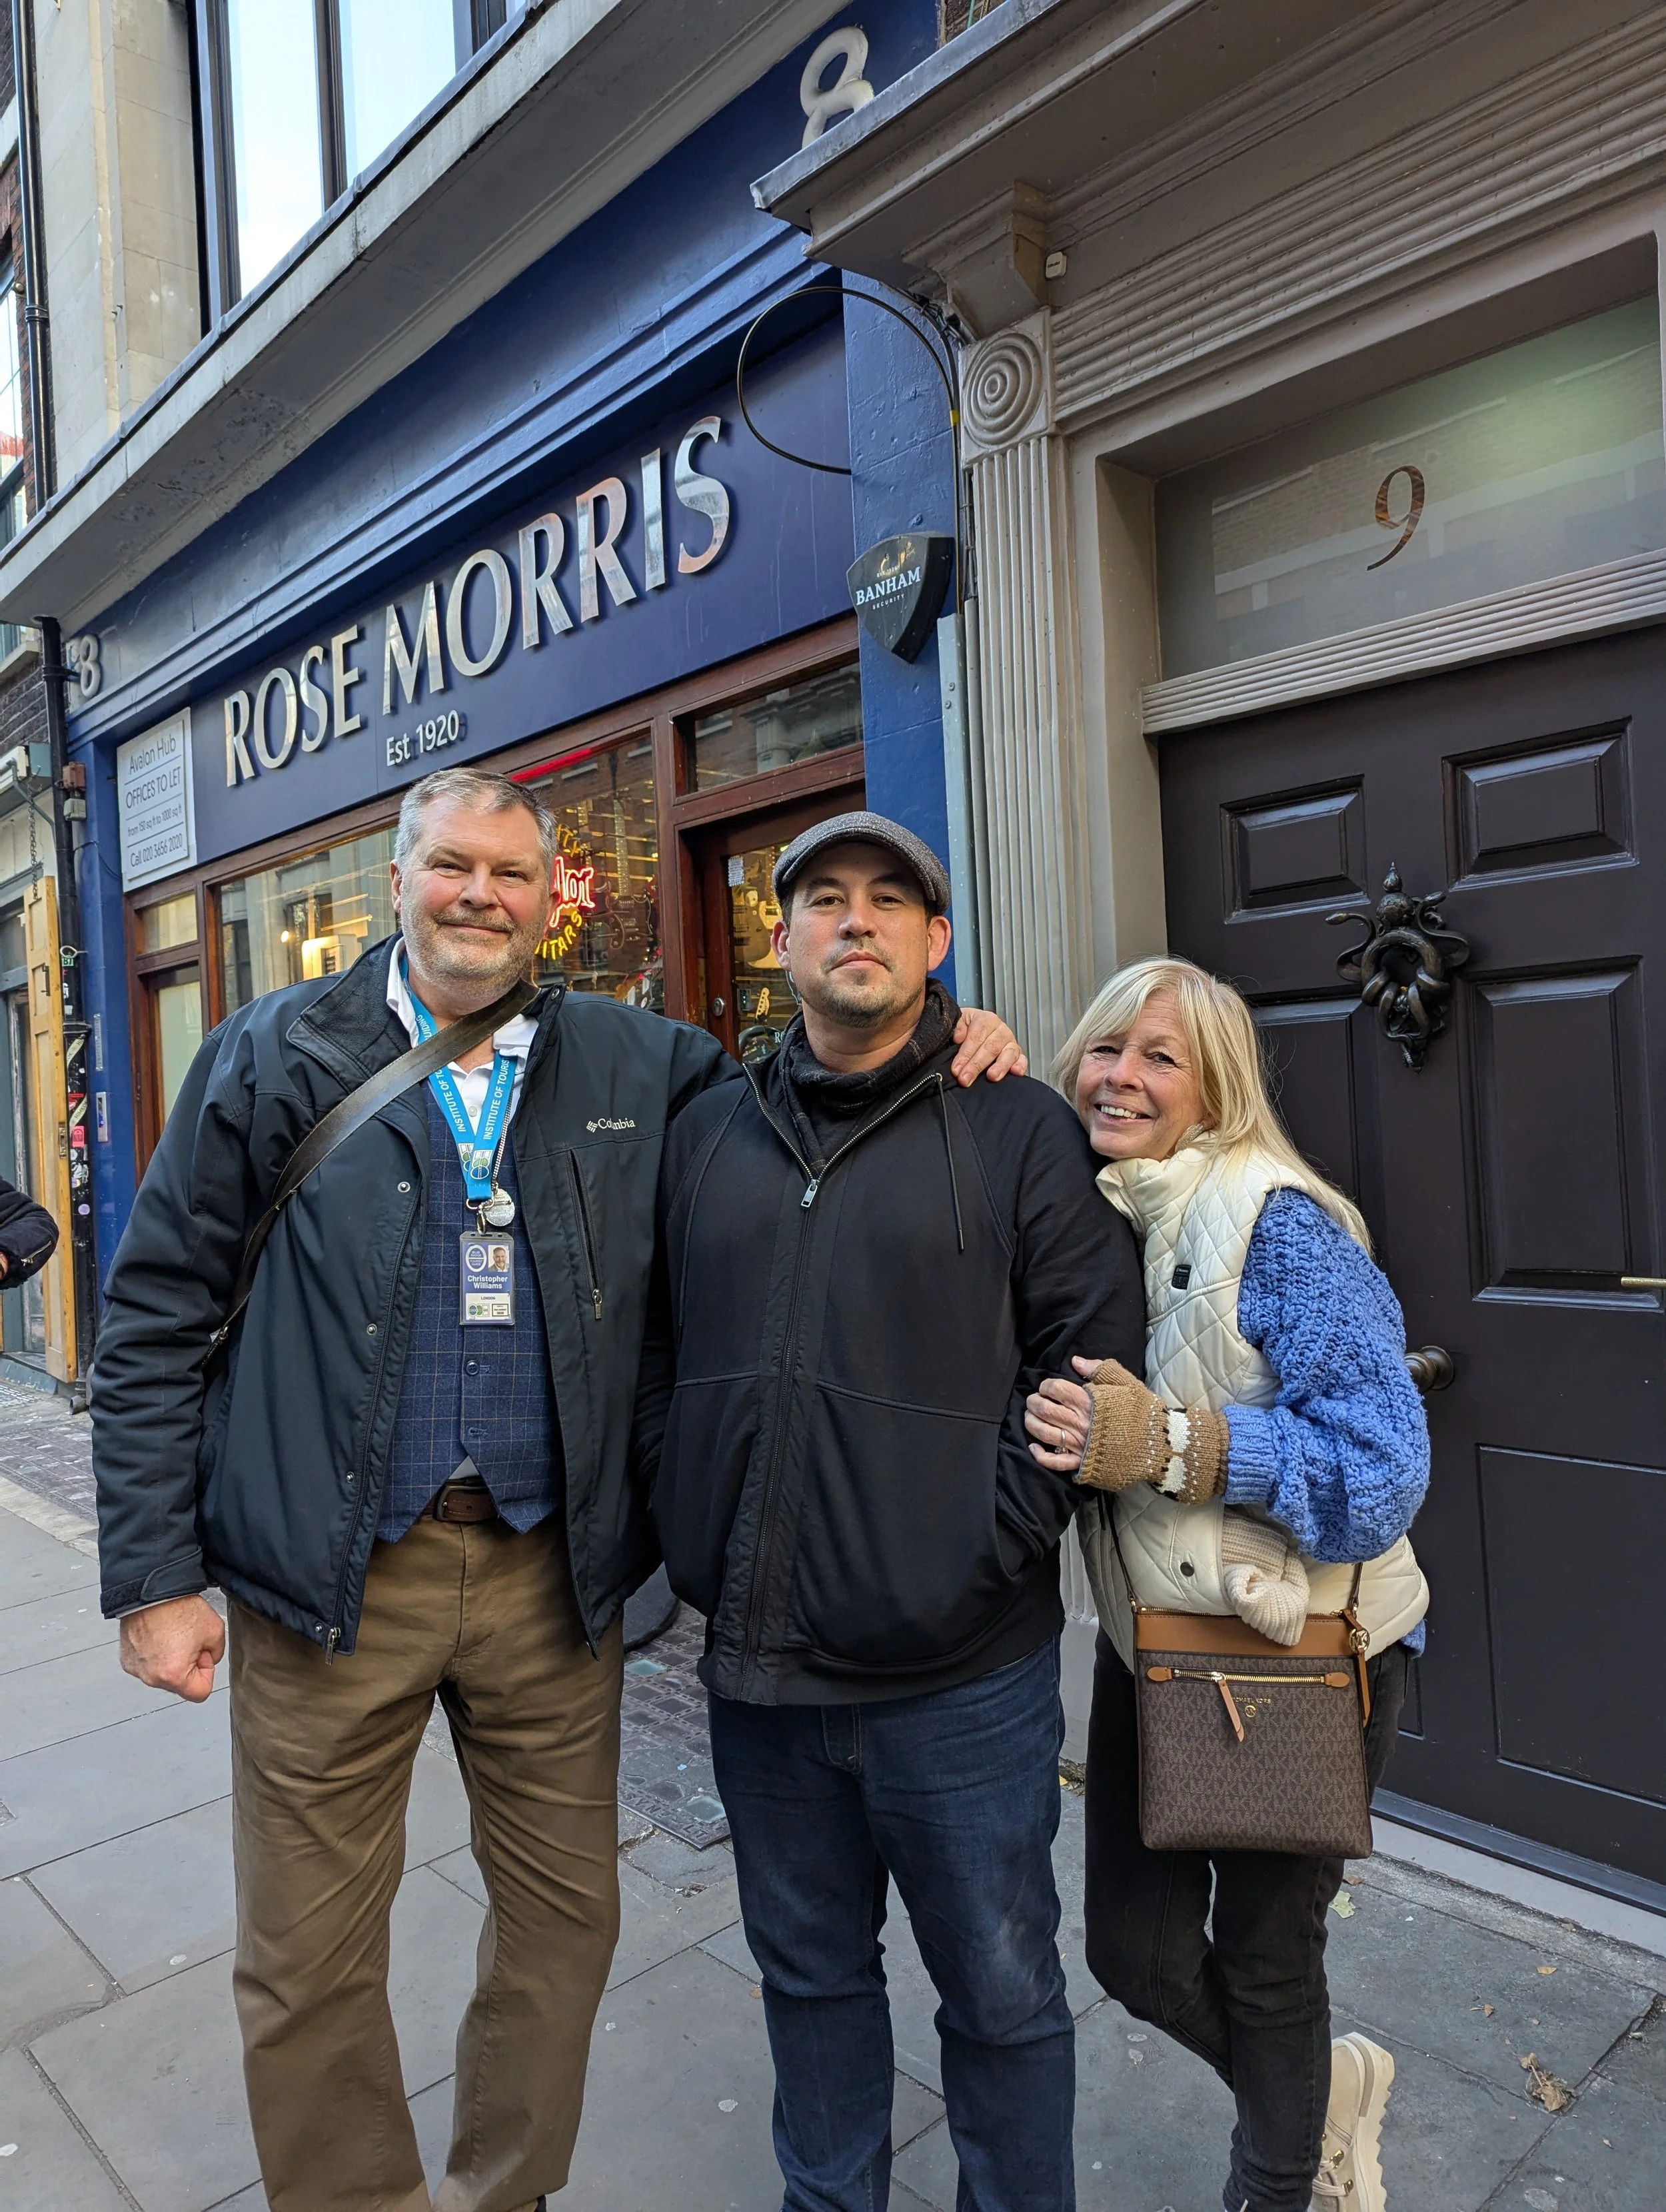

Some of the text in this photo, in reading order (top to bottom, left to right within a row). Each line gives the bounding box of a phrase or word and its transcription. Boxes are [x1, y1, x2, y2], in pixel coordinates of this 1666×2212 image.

[1367, 465, 1425, 571] 9
[224, 416, 730, 788] ROSE MORRIS
[856, 566, 921, 606] BANHAM
[872, 593, 904, 610] SECURITY
[81, 634, 101, 698] 8
[129, 734, 177, 775] Avalon Hub
[387, 710, 459, 767] Est 1920
[126, 766, 181, 809] OFFICES TO LET
[146, 820, 153, 830] sq
[172, 808, 179, 818] sq
[130, 833, 183, 867] Call 020 3656 2020
[534, 910, 582, 960] ITARS
[416, 1014, 432, 1041] UIDING
[438, 1079, 450, 1091] OF
[443, 1091, 467, 1132] INSTITUTE
[483, 1099, 500, 1140] INSTITUTE
[494, 1086, 504, 1099] OF
[467, 1275, 508, 1284] Christopher
